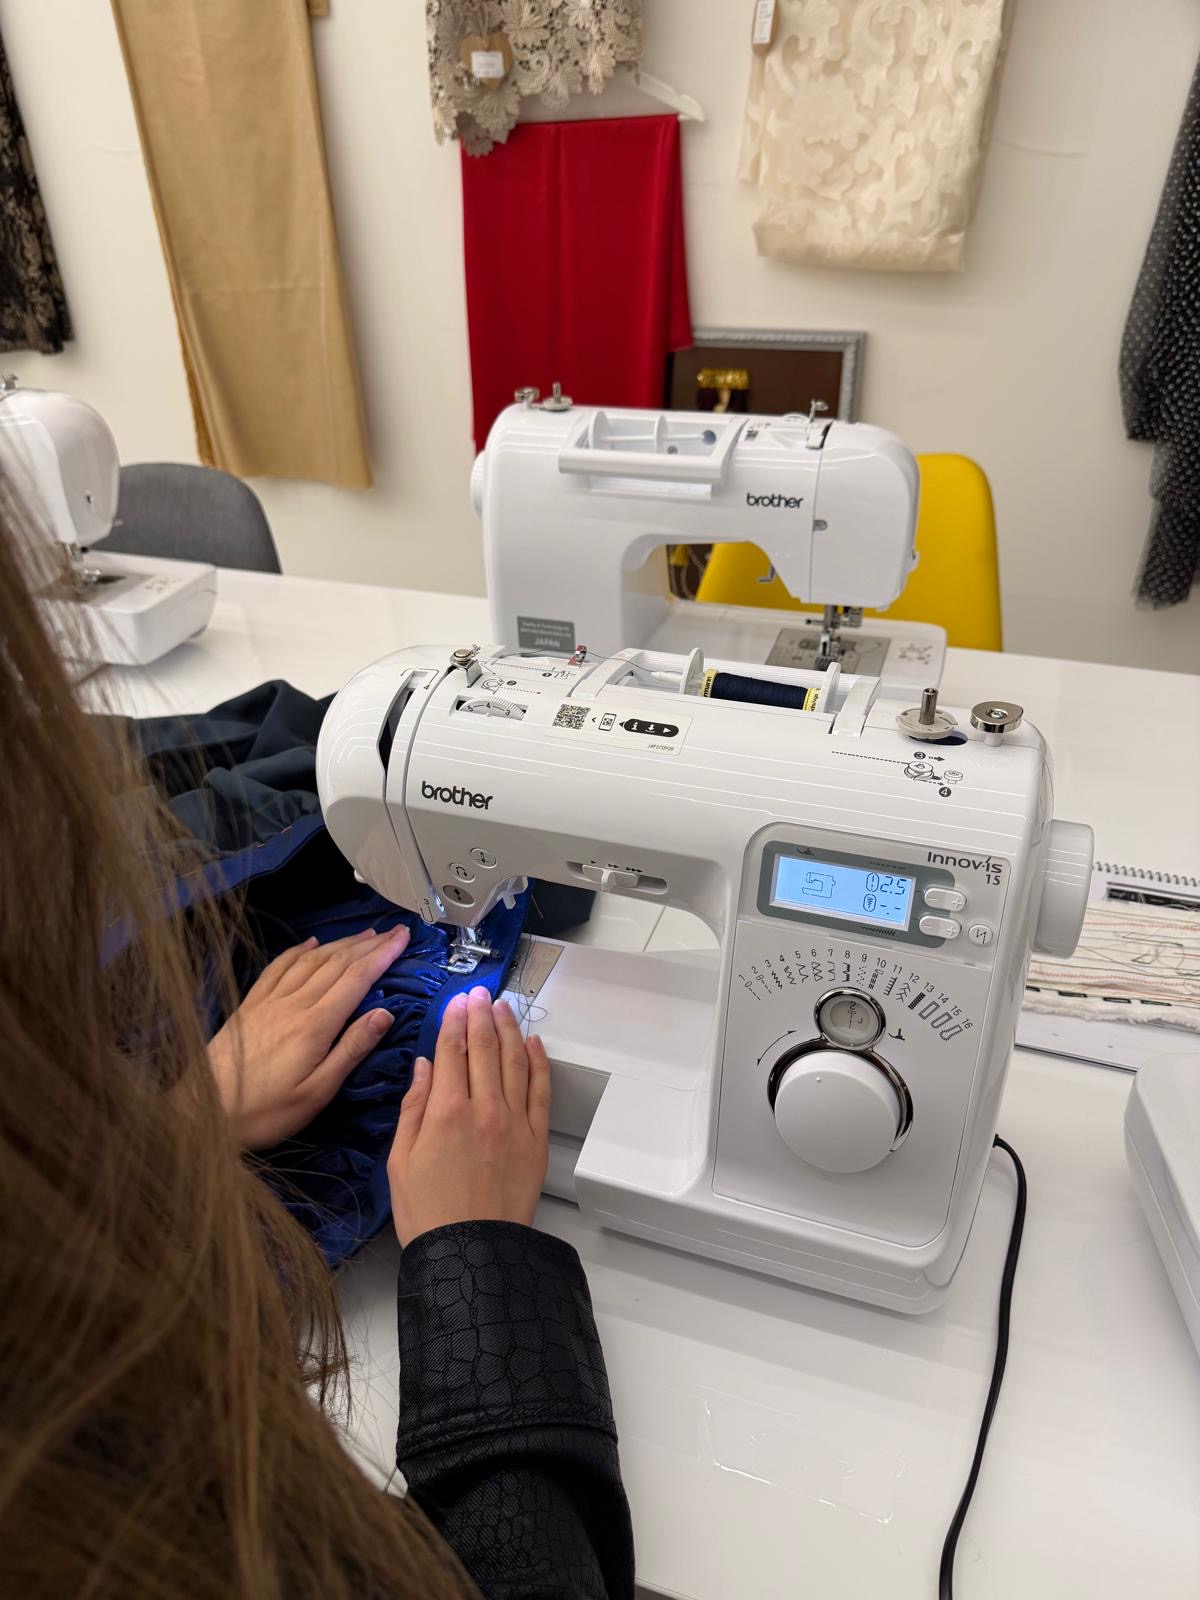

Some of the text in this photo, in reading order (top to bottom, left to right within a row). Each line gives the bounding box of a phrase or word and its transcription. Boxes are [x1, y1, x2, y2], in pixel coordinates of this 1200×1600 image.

[746, 493, 803, 509] brother
[421, 780, 493, 810] brother
[880, 876, 907, 895] 2.5
[986, 874, 1001, 886] 15
[752, 966, 758, 974] 2
[765, 959, 772, 968] 3
[779, 954, 785, 962] 4
[795, 950, 801, 959] 5
[811, 949, 817, 957] 6
[827, 949, 834, 957] 7
[844, 950, 851, 959] 8
[861, 953, 868, 962] 9
[876, 958, 887, 968] 10
[892, 965, 903, 974] 11
[908, 973, 920, 983] 12
[923, 982, 935, 993] 13
[937, 993, 949, 1004] 14
[950, 1005, 962, 1016] 15
[962, 1018, 974, 1029] 16
